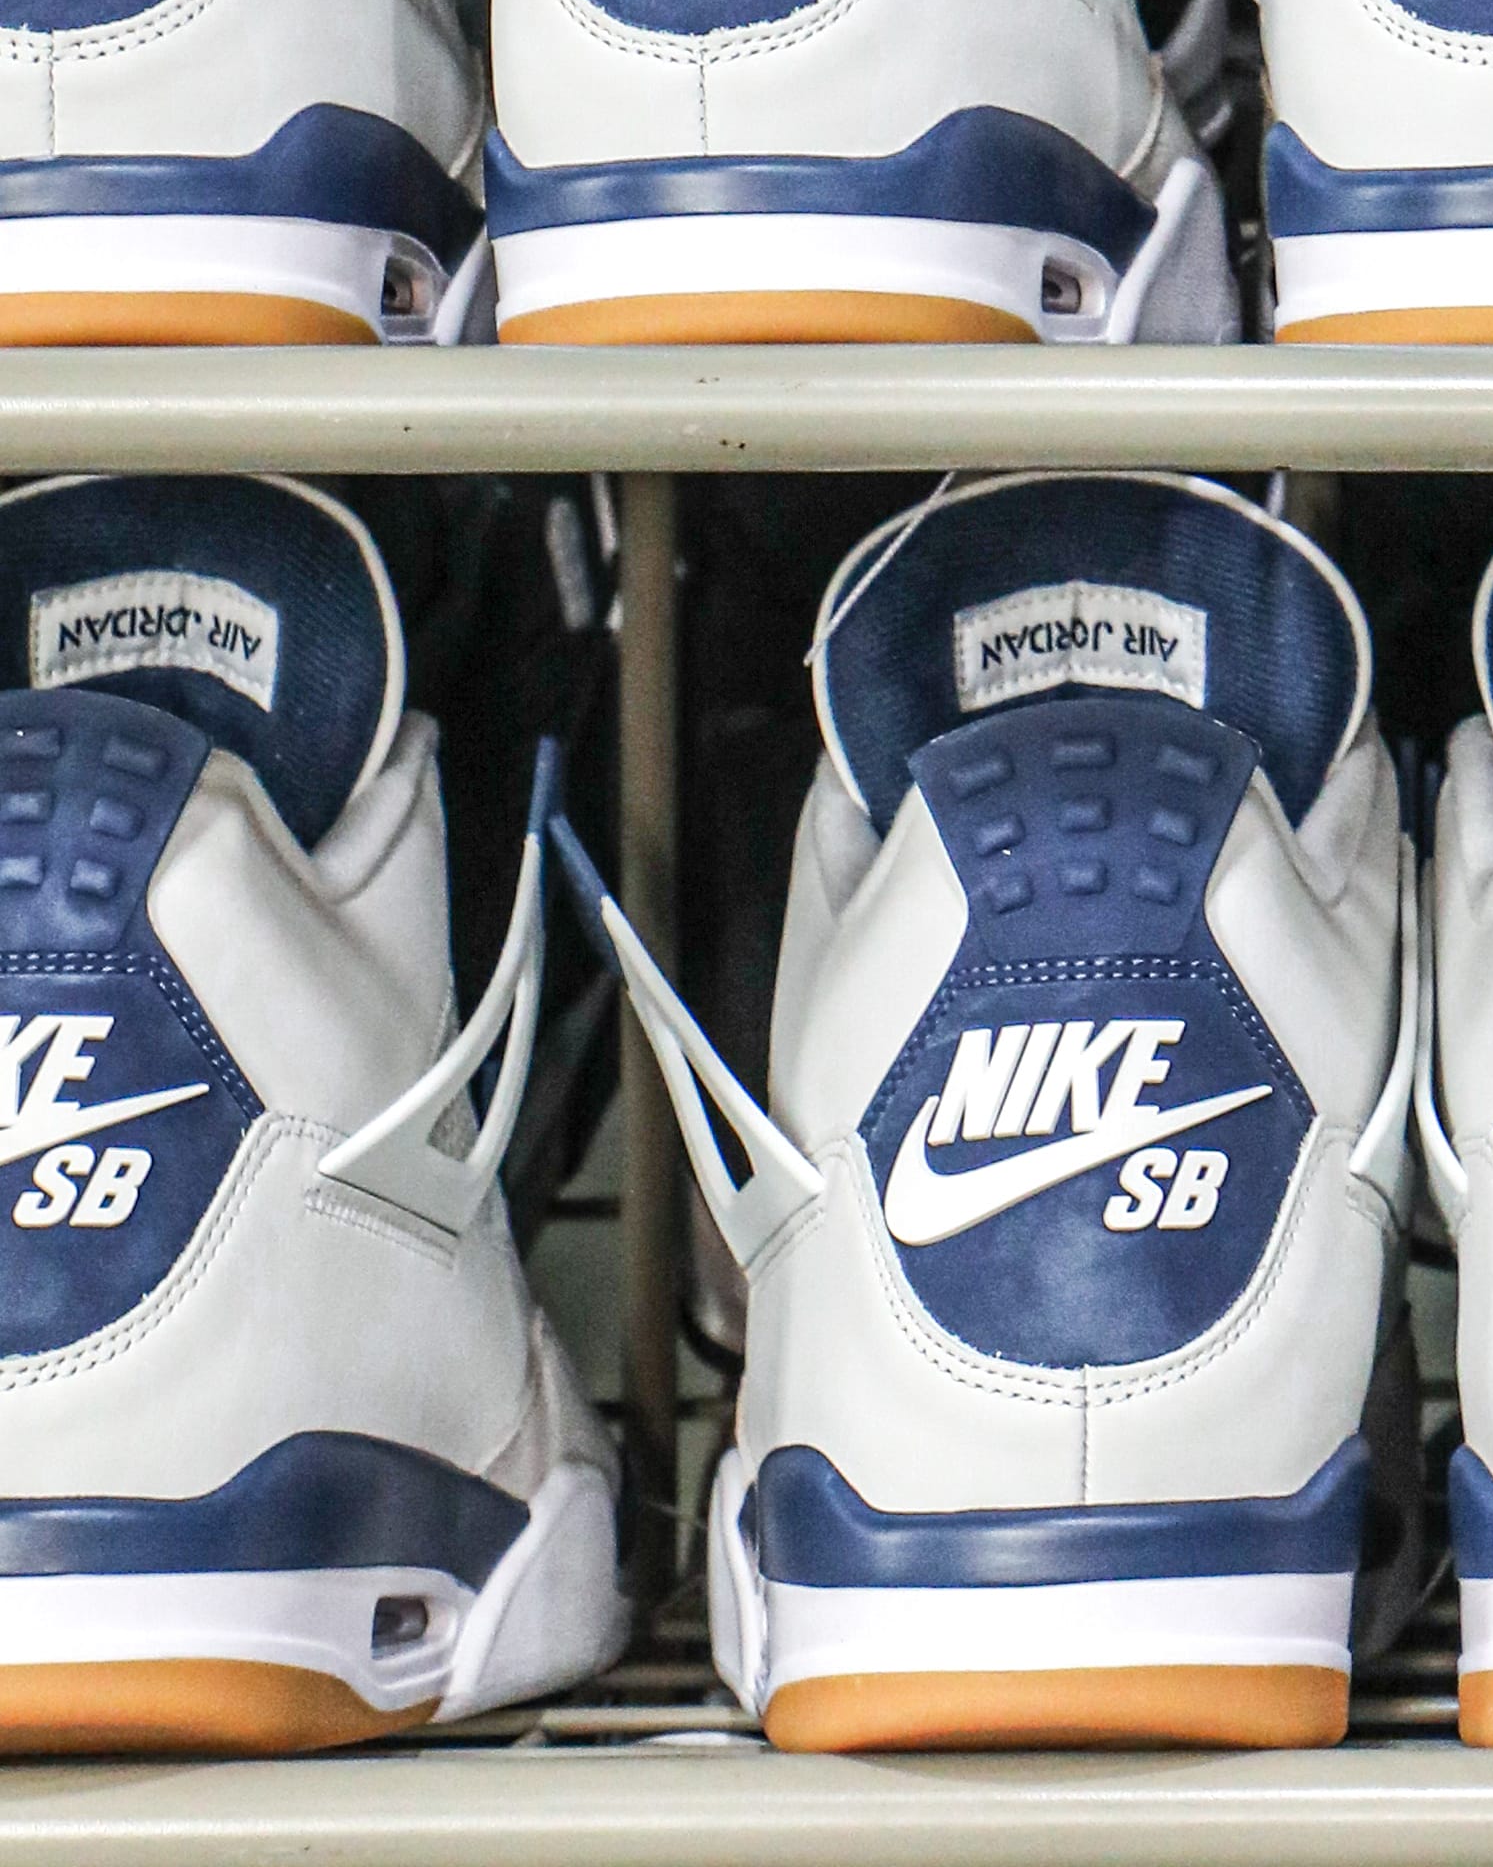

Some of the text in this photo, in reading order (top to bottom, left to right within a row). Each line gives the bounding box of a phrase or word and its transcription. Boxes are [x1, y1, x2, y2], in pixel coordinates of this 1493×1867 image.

[208, 614, 262, 660] AIR
[981, 617, 1179, 670] AIR JORDAN
[0, 1014, 115, 1129] KE
[928, 1018, 1180, 1145] NIKE
[12, 1143, 152, 1229] SB
[1101, 1145, 1231, 1232] SB
